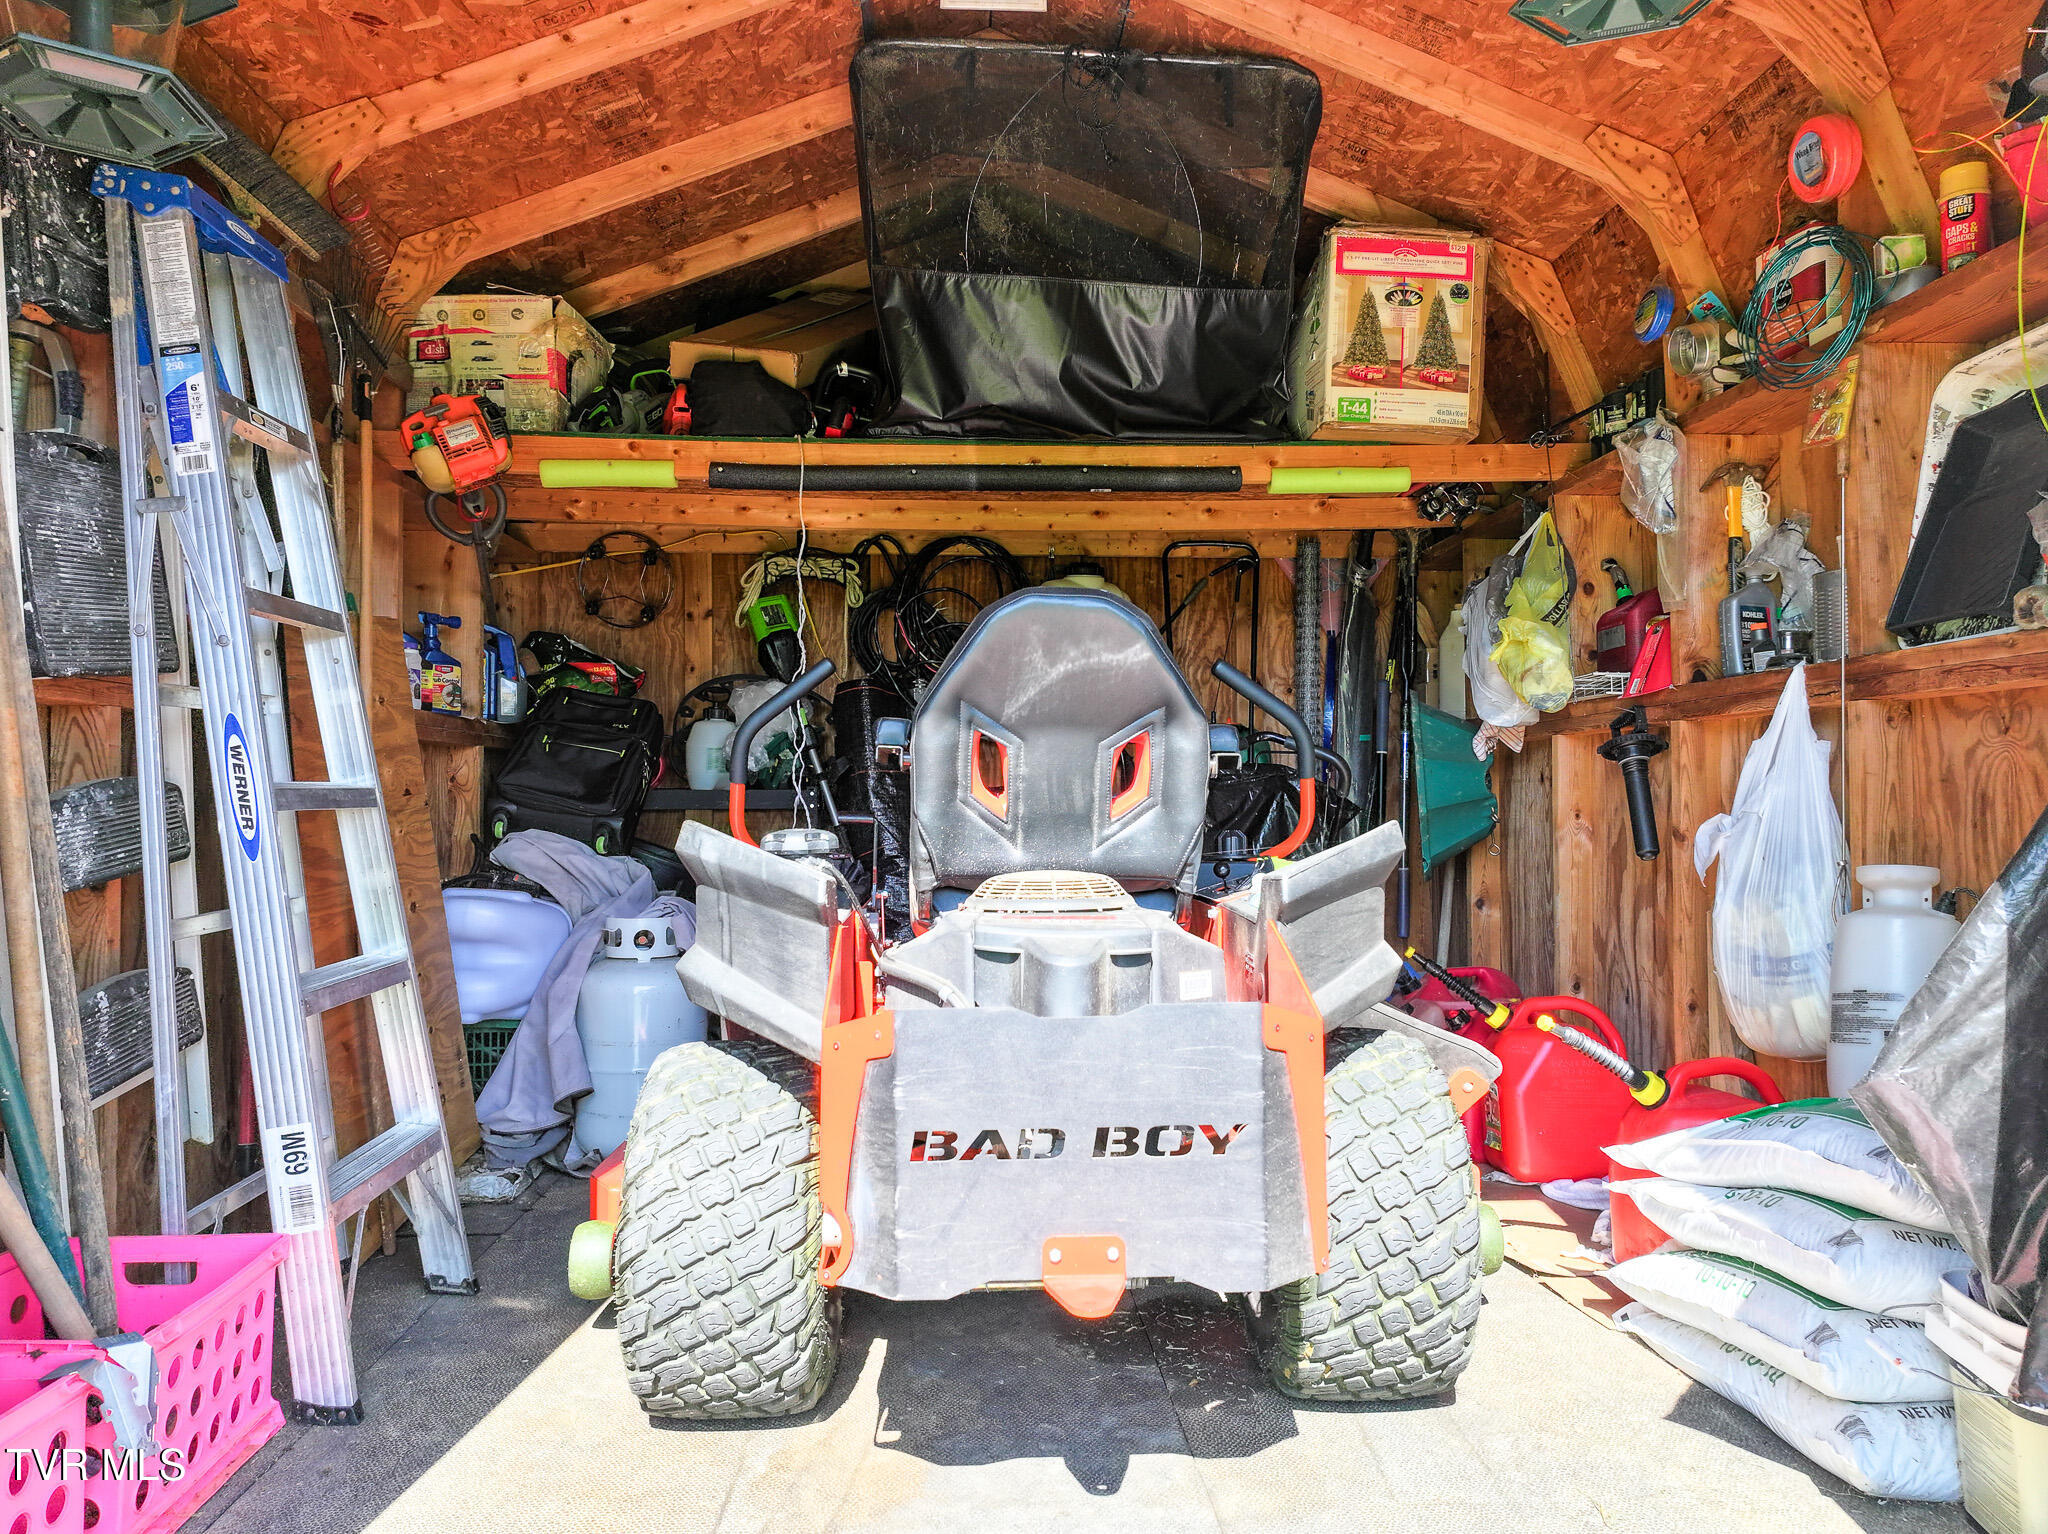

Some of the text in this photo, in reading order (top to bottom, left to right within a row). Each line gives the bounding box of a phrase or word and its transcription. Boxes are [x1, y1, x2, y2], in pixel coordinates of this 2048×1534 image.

[1948, 196, 1973, 209] GREAT
[1948, 204, 1974, 218] STUFF
[1945, 222, 1978, 240] GAPS &
[1948, 232, 1976, 246] CRACKS
[424, 344, 445, 356] dish
[166, 362, 184, 371] 250
[1340, 402, 1368, 414] T-44
[647, 408, 664, 424] EGO
[1742, 610, 1765, 619] KOHLER
[230, 744, 255, 832] WERNER
[909, 1123, 1249, 1162] BAD BOY
[280, 1131, 312, 1176] W69
[1892, 1230, 1958, 1252] NET WT.
[1866, 1318, 1899, 1330] NET
[1898, 1406, 1933, 1420] NET
